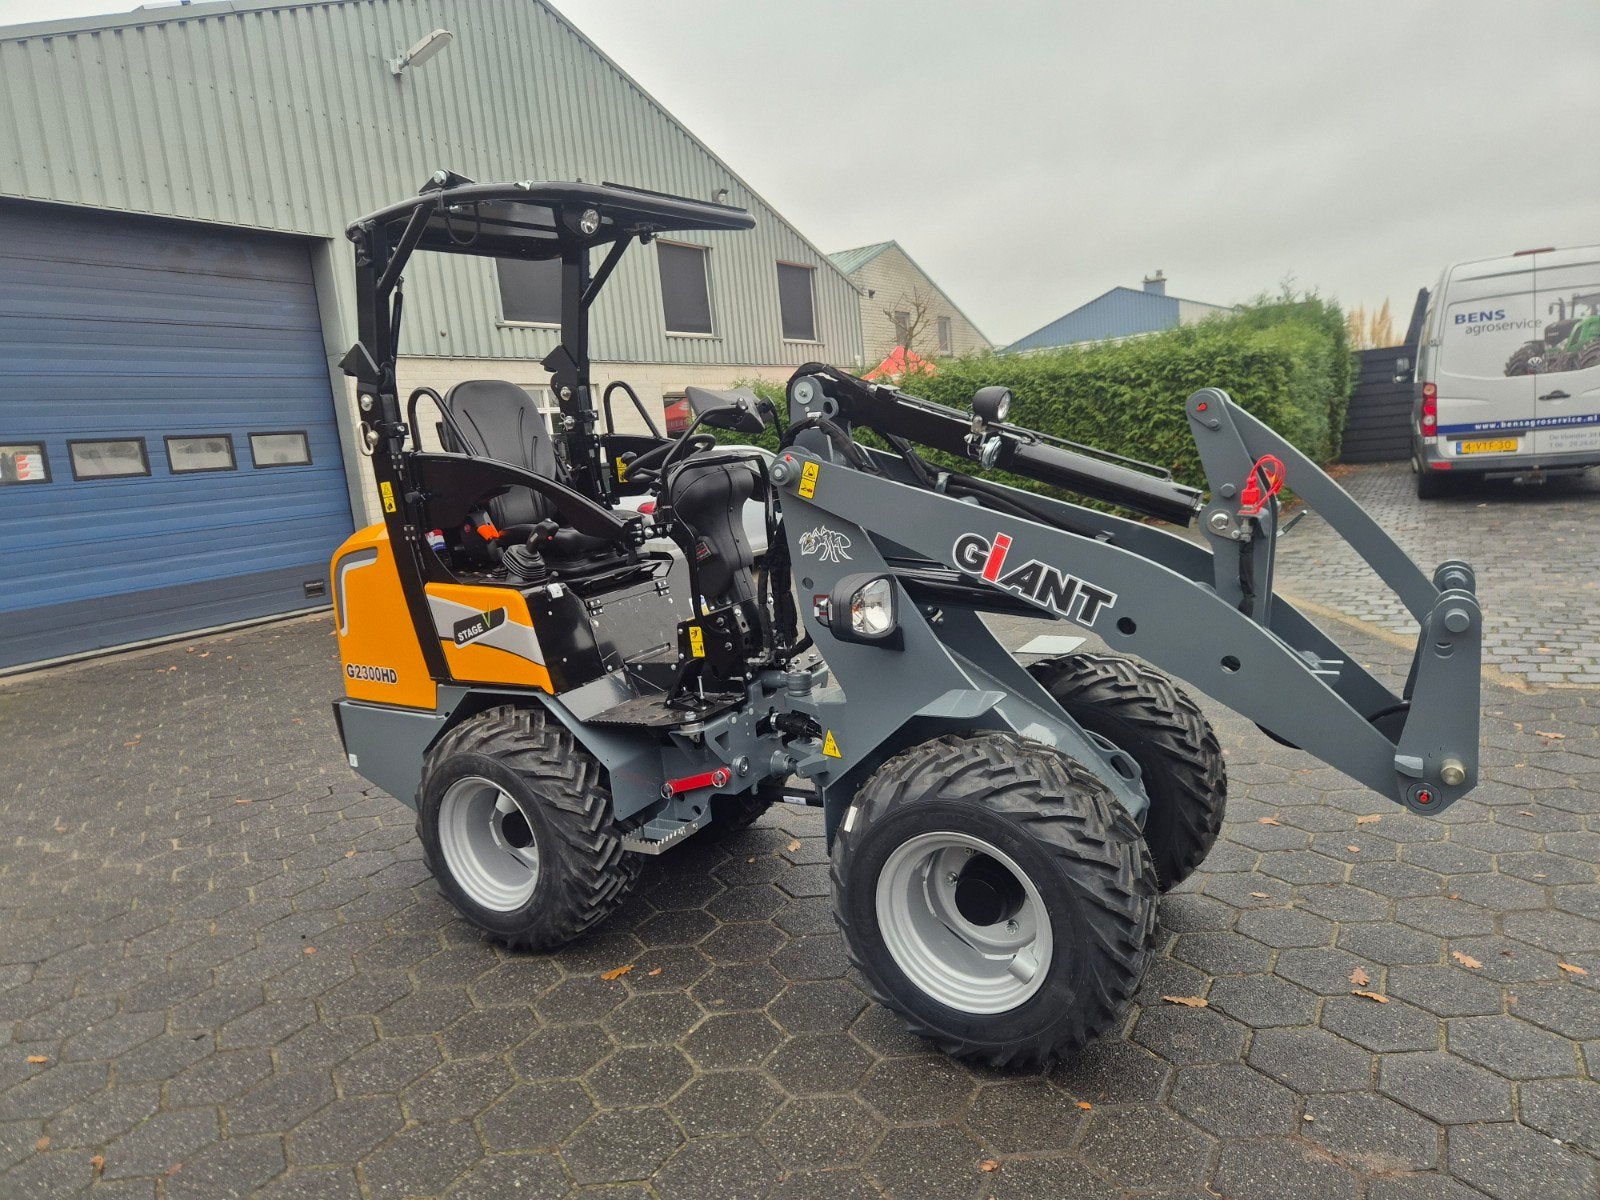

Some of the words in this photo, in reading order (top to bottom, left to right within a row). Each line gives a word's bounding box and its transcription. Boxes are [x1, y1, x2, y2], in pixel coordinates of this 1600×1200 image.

[1454, 309, 1506, 325] BENS
[1465, 318, 1543, 336] agroservice
[1474, 414, 1598, 430] www.bensagroservice.nl
[457, 622, 484, 642] STAGE
[346, 663, 398, 685] G2300HD
